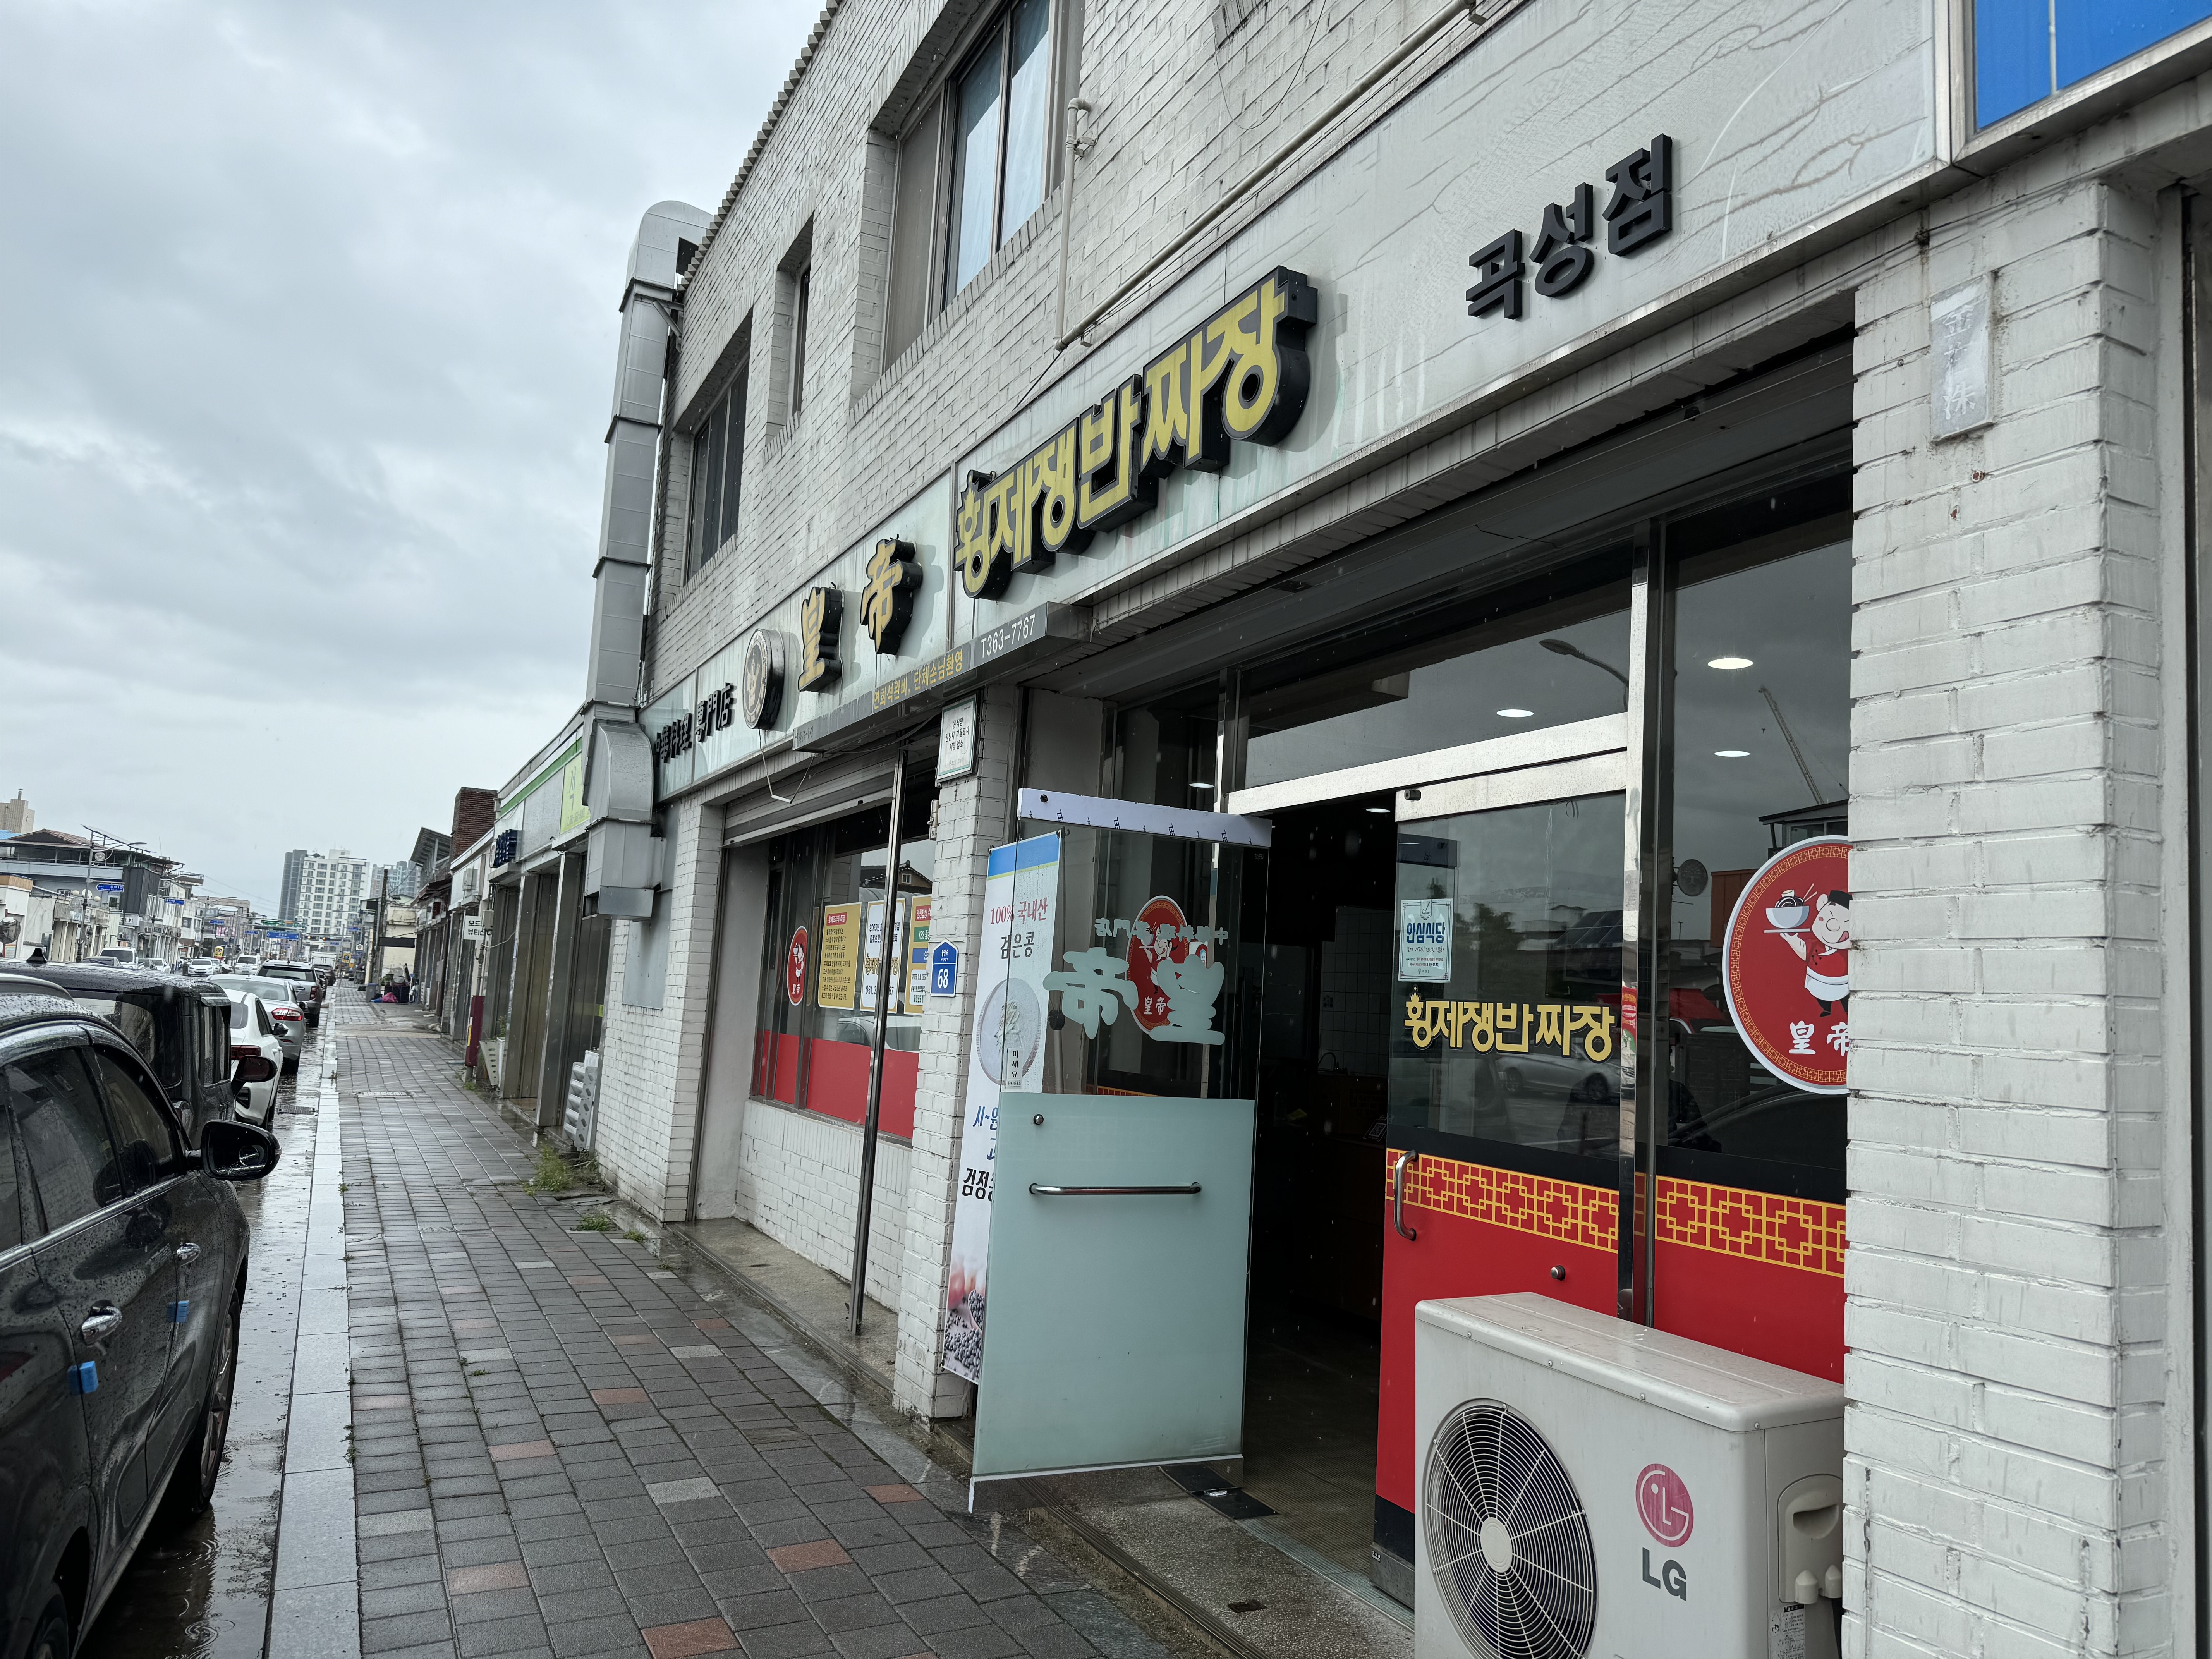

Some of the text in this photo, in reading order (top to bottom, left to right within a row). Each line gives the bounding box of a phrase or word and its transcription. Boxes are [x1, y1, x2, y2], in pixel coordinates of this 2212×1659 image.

[1466, 133, 1673, 321] 곡성점
[953, 271, 1297, 599] 황제쟁반짜장
[914, 649, 963, 691] 단체손님환영
[953, 717, 963, 729] 음식점
[990, 897, 1048, 925] 100% 국내산
[1000, 931, 1034, 959] 검은콩
[1407, 922, 1446, 943] 안심식당
[938, 969, 949, 988] 68
[1144, 996, 1166, 1015] 皇帝
[1404, 987, 1615, 1061] 황제쟁반짜장
[1642, 1547, 1687, 1602] LG
